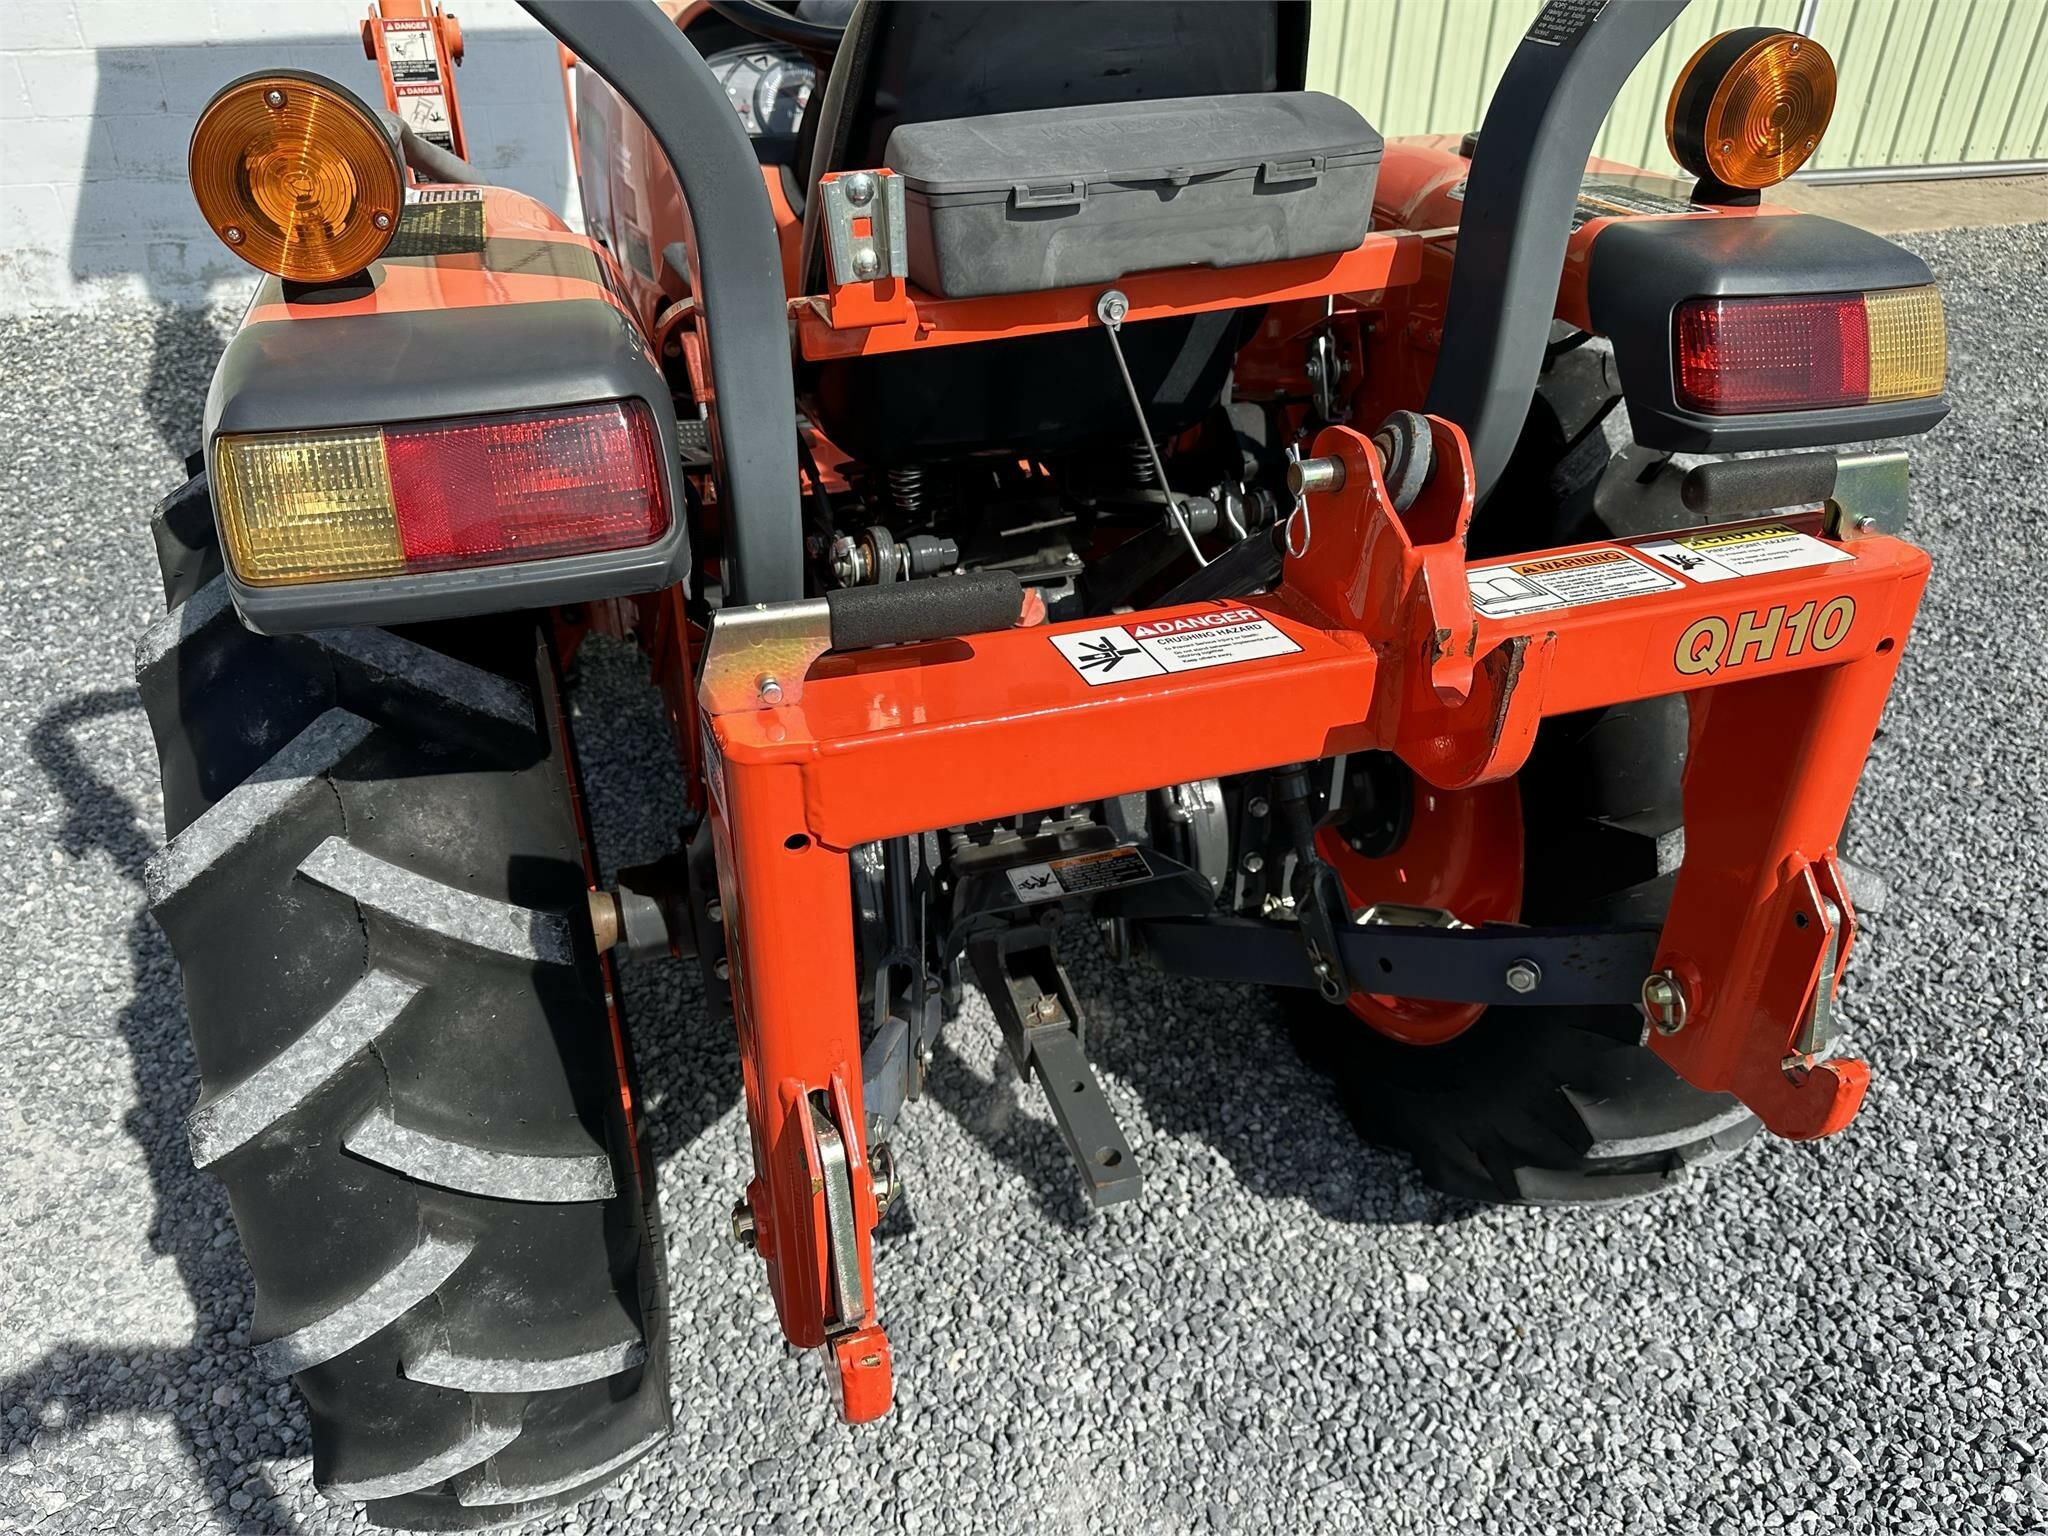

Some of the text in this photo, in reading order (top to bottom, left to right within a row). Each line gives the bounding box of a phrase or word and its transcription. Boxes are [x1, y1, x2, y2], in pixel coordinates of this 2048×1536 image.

[394, 22, 428, 30] DANGER
[406, 87, 440, 95] DANGER
[1703, 527, 1792, 542] CAUTION
[1536, 553, 1621, 569] WARNING
[1153, 609, 1258, 632] DANGER
[1157, 624, 1262, 644] CRUSHING HAZARD
[1674, 595, 1856, 675] QH10
